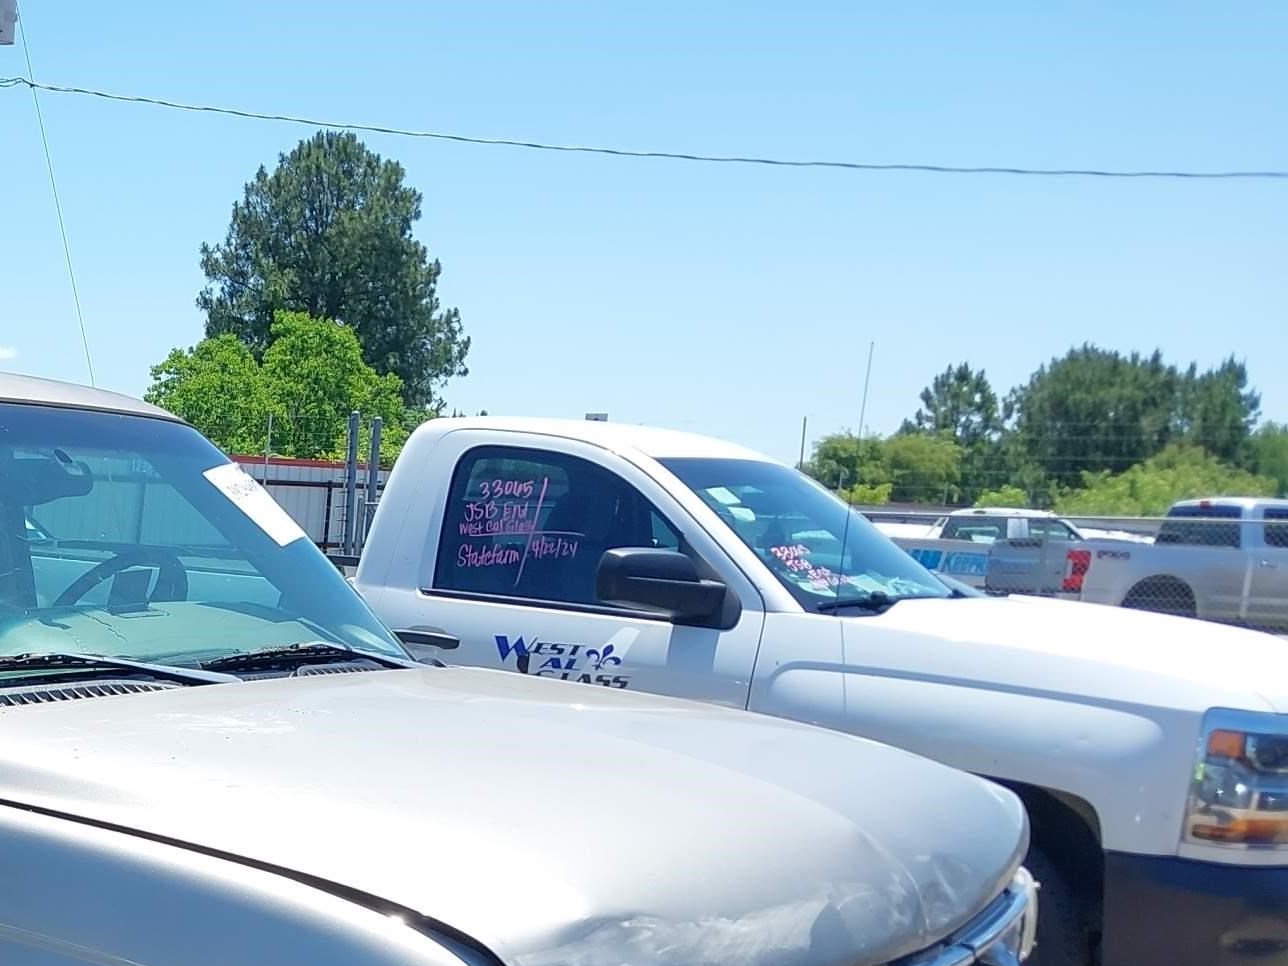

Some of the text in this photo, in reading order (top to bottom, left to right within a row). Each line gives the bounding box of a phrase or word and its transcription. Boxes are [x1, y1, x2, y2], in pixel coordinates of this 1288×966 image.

[464, 500, 498, 521] JSB
[531, 536, 578, 559] 4/22/24
[494, 635, 586, 663] WEST
